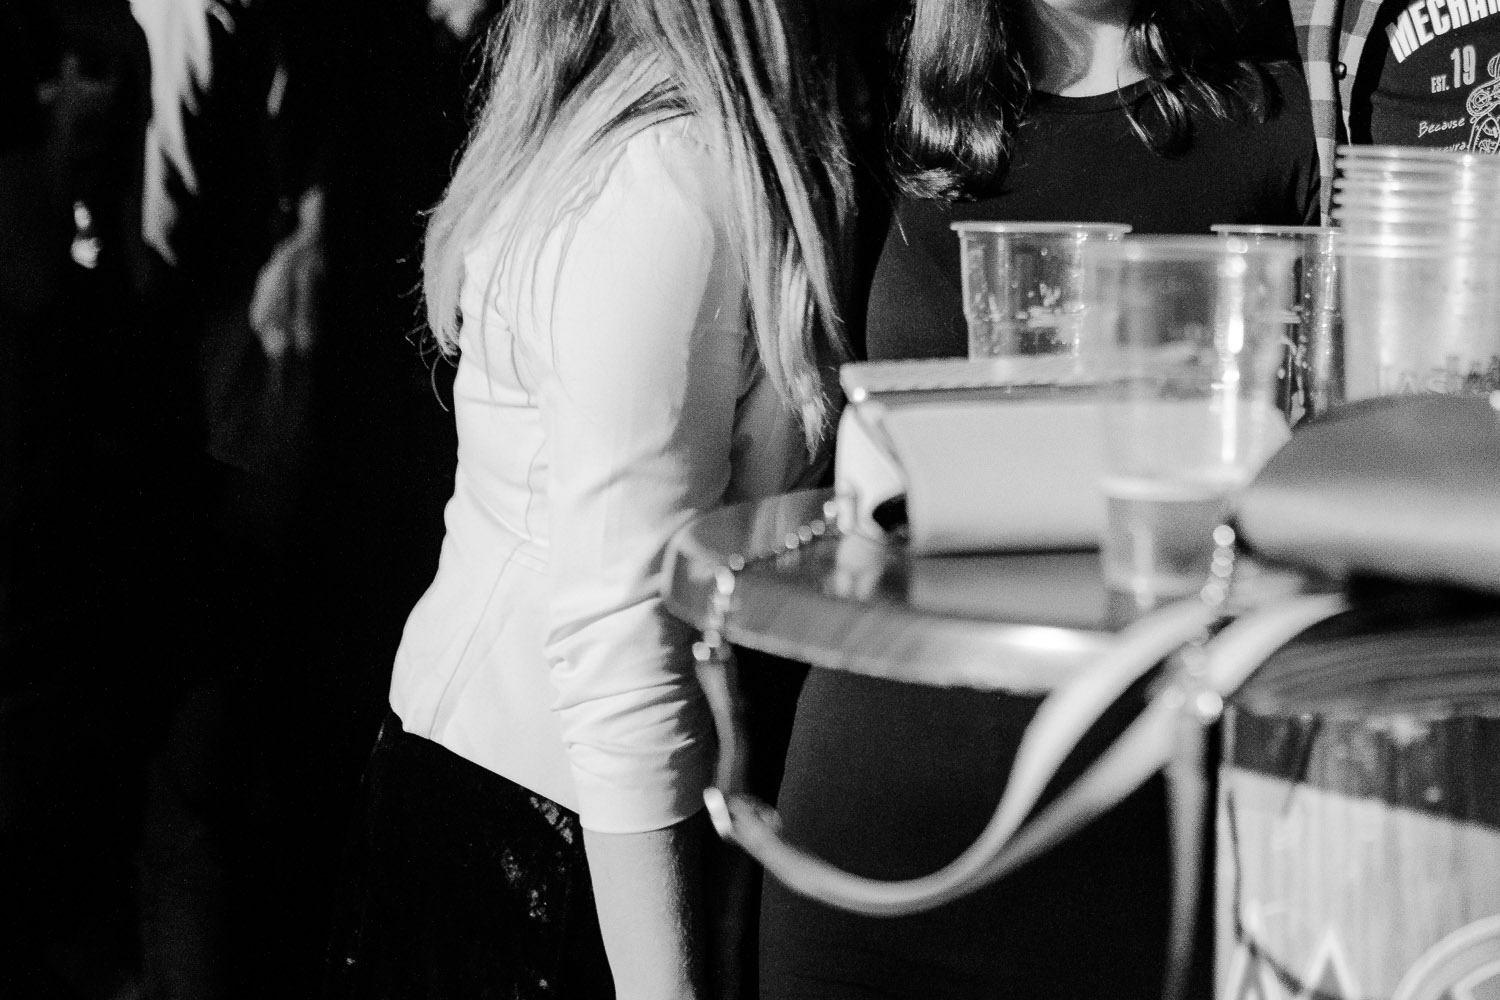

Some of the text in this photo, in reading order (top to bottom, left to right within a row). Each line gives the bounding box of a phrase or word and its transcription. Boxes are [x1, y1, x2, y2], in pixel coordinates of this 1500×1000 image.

[1430, 74, 1450, 93] EST.
[1450, 45, 1476, 89] 19
[1418, 117, 1466, 138] Because
